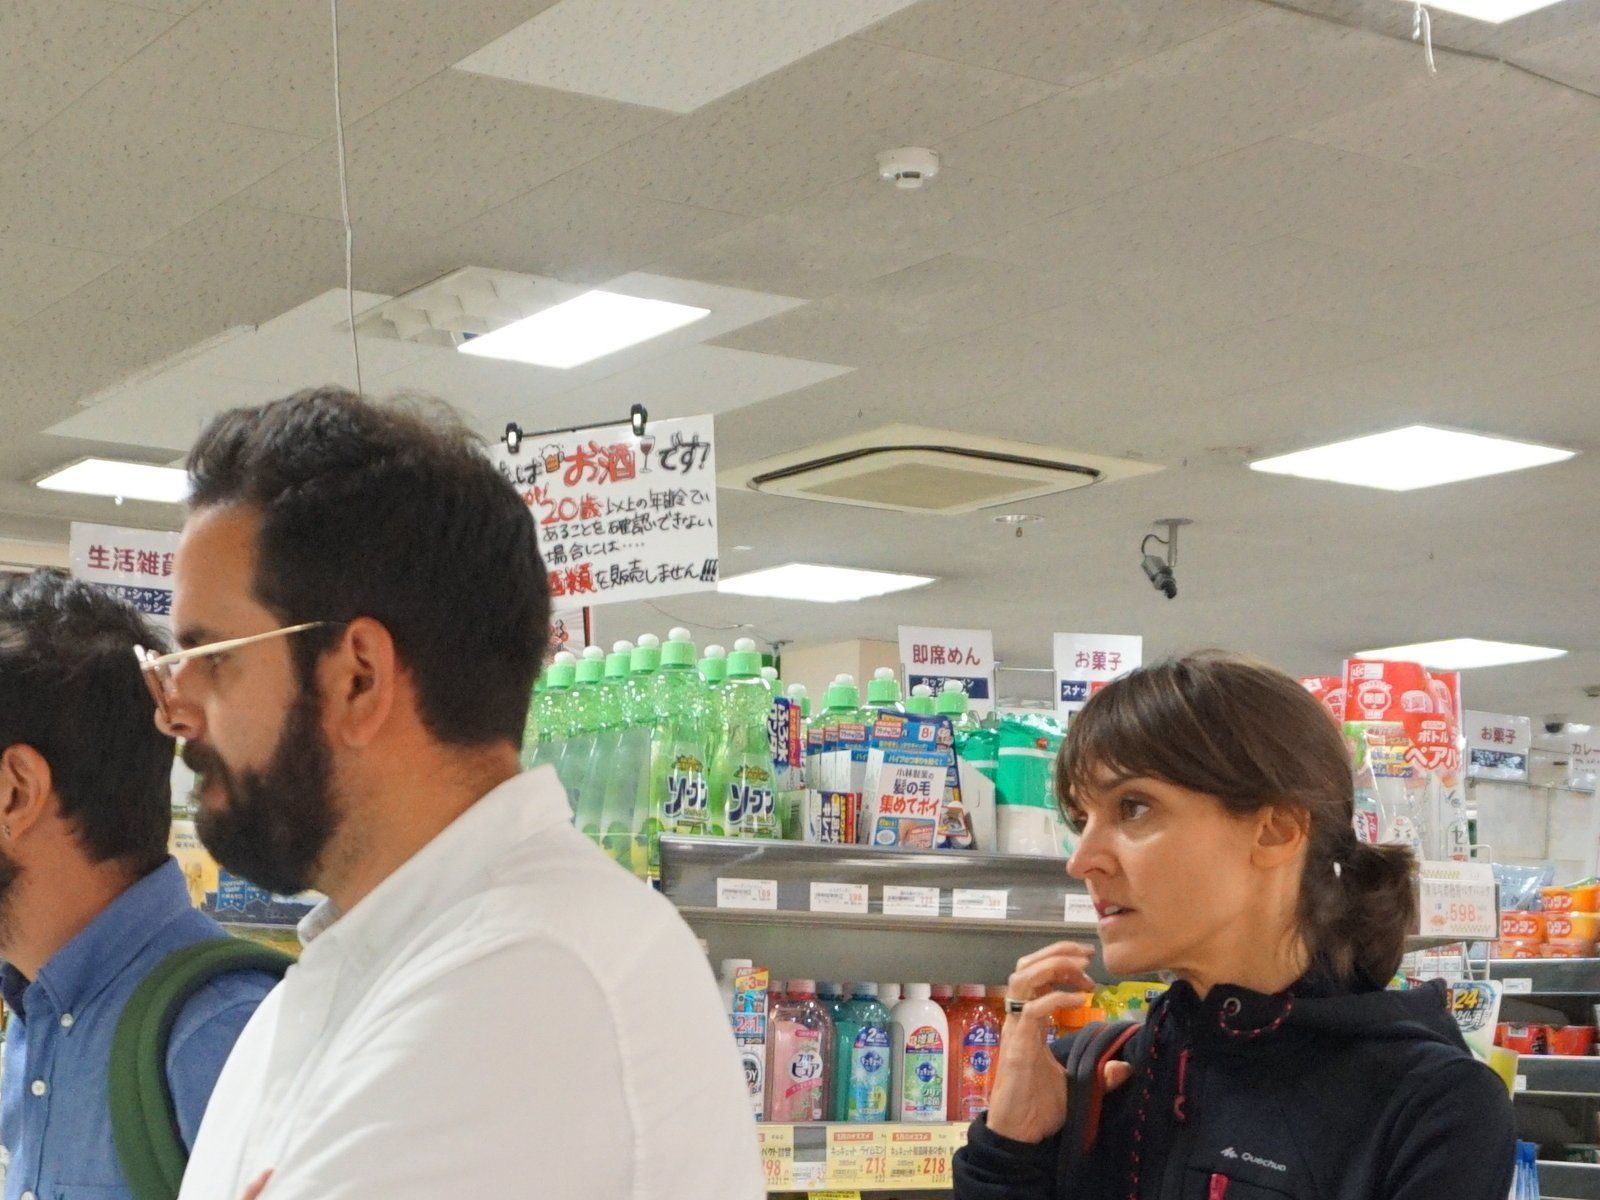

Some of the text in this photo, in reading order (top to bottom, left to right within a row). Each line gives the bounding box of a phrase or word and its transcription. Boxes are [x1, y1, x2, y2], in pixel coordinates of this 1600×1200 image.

[563, 440, 636, 487] お酒
[542, 512, 713, 542] あることを確認できない
[912, 644, 980, 666] 即席めん
[1075, 651, 1122, 671] お菓子
[1062, 684, 1088, 697] スナッ
[1481, 727, 1516, 745] お菓子
[893, 781, 931, 796] 髪の毛
[879, 794, 940, 815] 集めてポイ
[1450, 904, 1477, 921] 598
[923, 1158, 946, 1174] 218
